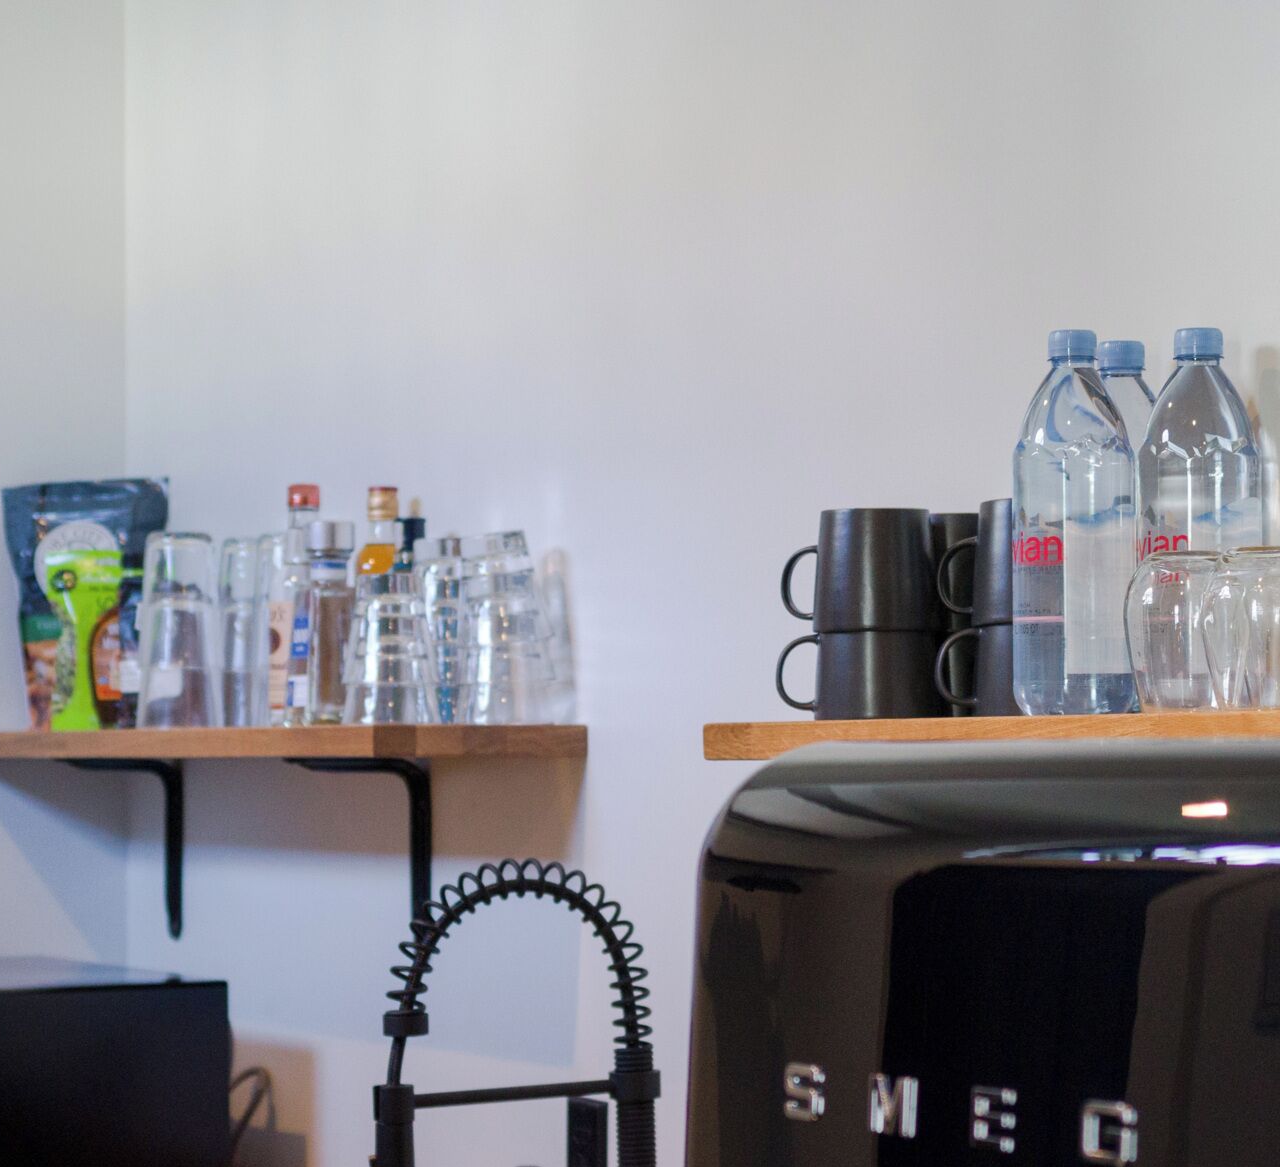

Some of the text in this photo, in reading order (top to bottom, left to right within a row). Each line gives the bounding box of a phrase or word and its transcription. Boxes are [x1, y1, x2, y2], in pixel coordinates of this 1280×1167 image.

[1012, 531, 1064, 563] vian
[1136, 530, 1189, 561] vian
[784, 1061, 1138, 1167] SMEG
